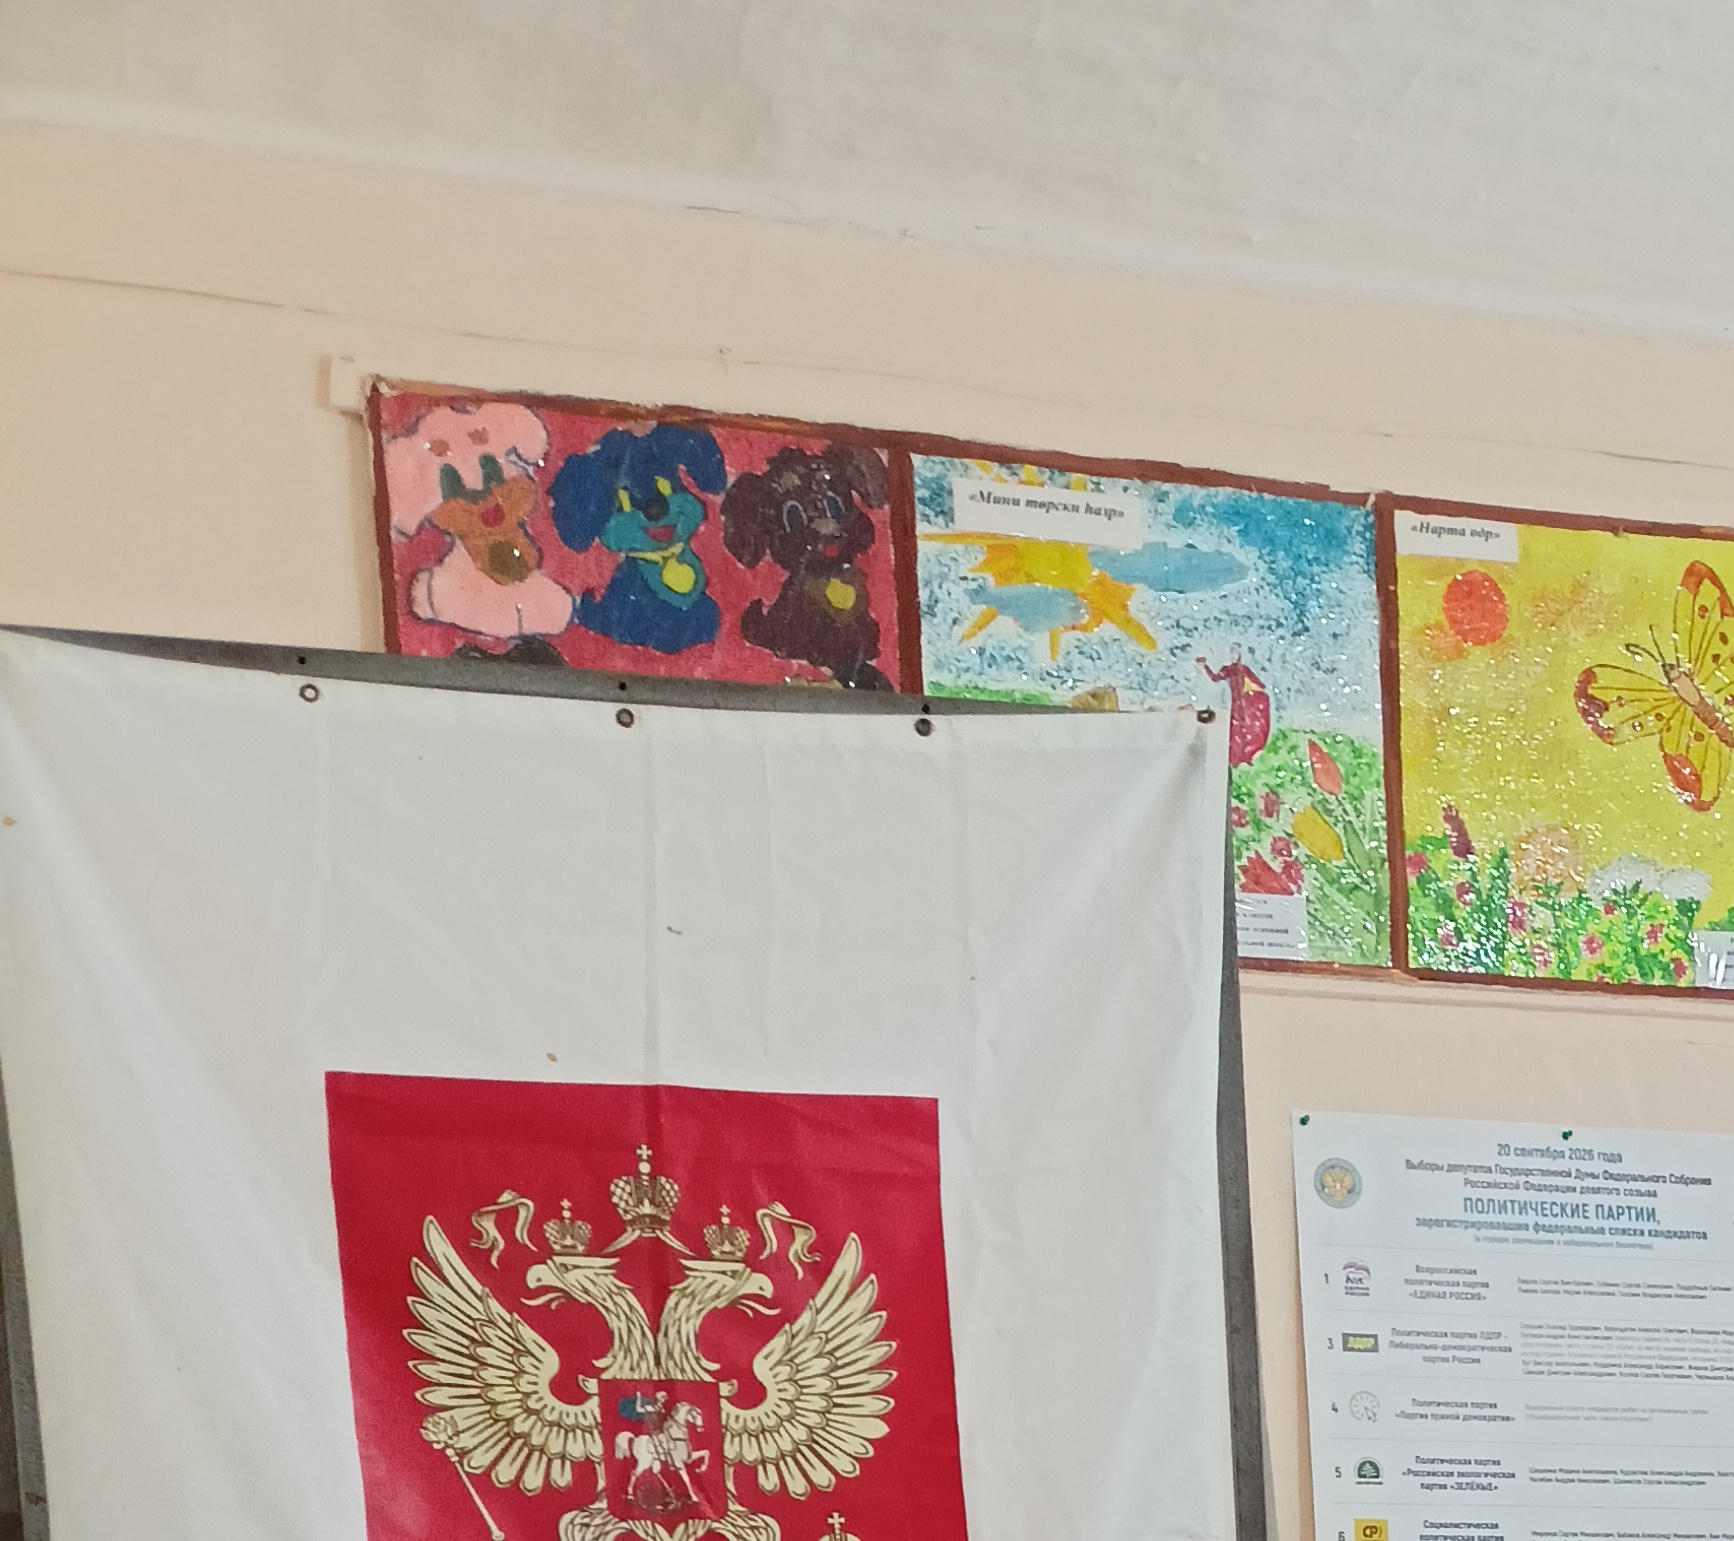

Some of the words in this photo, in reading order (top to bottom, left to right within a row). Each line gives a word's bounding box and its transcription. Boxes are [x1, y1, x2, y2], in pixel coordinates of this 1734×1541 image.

[1411, 522, 1465, 538] «Нарта
[1497, 1143, 1510, 1157] 20
[1513, 1146, 1565, 1159] сентября
[1569, 1148, 1594, 1161] 2026
[1597, 1151, 1623, 1164] года
[1405, 1159, 1444, 1172] Выборы
[1463, 1178, 1520, 1190] Российской
[1463, 1197, 1590, 1219] ПОЛИТИЧЕСКИЕ
[1595, 1204, 1660, 1225] ПАРТИИ,
[1416, 1216, 1530, 1232] зарегистрировавшие
[1532, 1221, 1605, 1236] федеральные
[1608, 1227, 1644, 1237] списки
[1647, 1228, 1707, 1240] кандидатов
[1324, 1274, 1329, 1284] 1
[1328, 1338, 1334, 1349] 3
[1331, 1402, 1338, 1413] 4
[1335, 1467, 1342, 1478] 5
